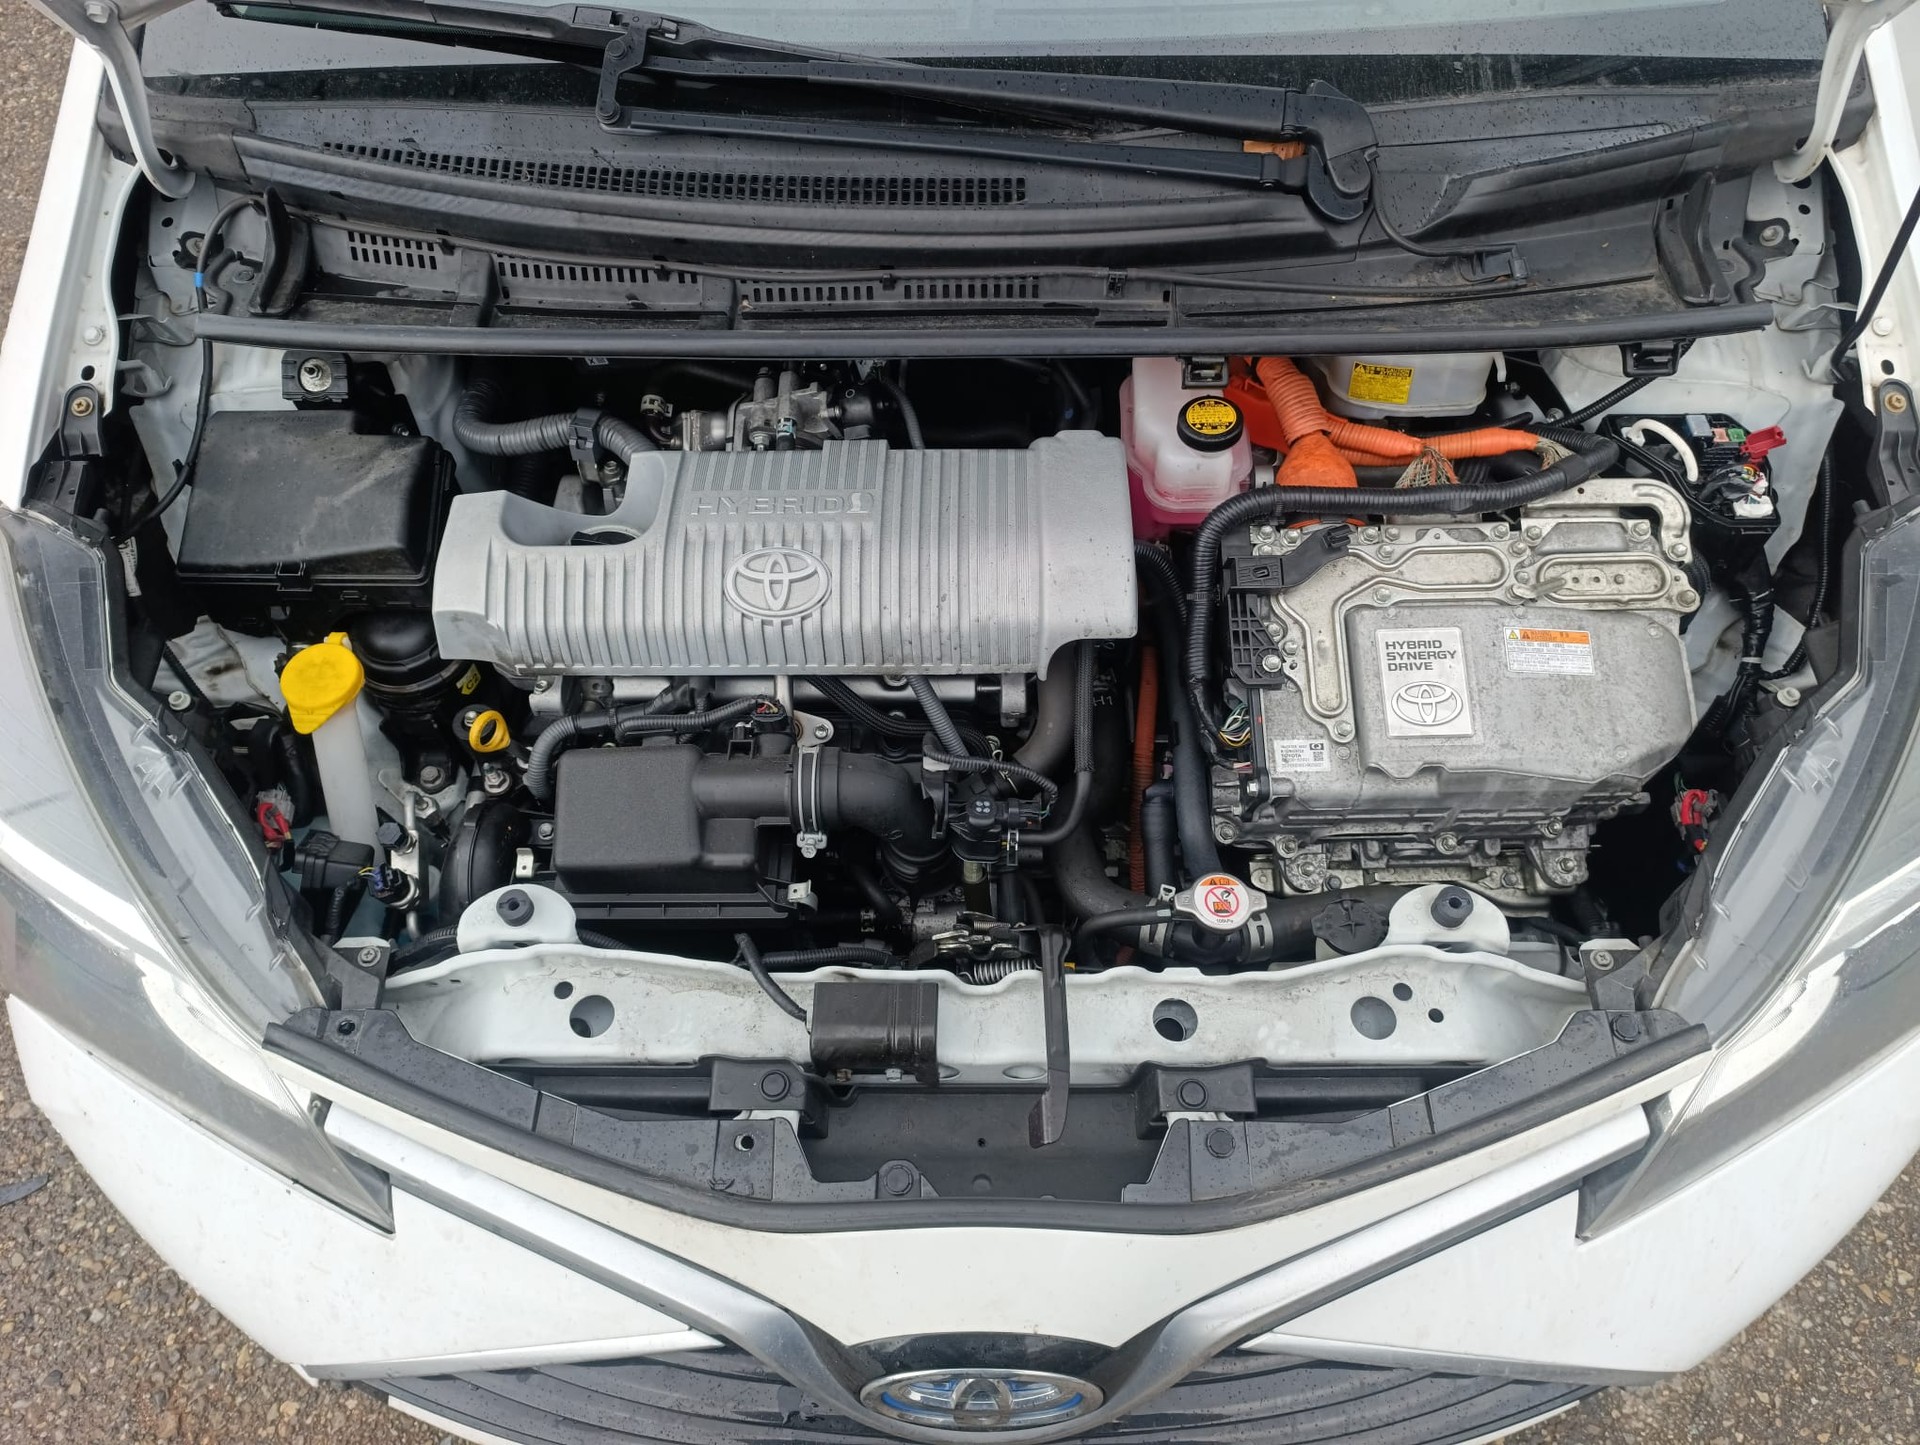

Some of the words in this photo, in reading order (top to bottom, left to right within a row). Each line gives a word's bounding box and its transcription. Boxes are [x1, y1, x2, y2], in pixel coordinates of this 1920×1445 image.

[690, 496, 844, 516] HYBRID
[1385, 640, 1443, 650] HYBRID
[1386, 650, 1457, 661] SYNERGY
[1388, 661, 1433, 672] DRIVE
